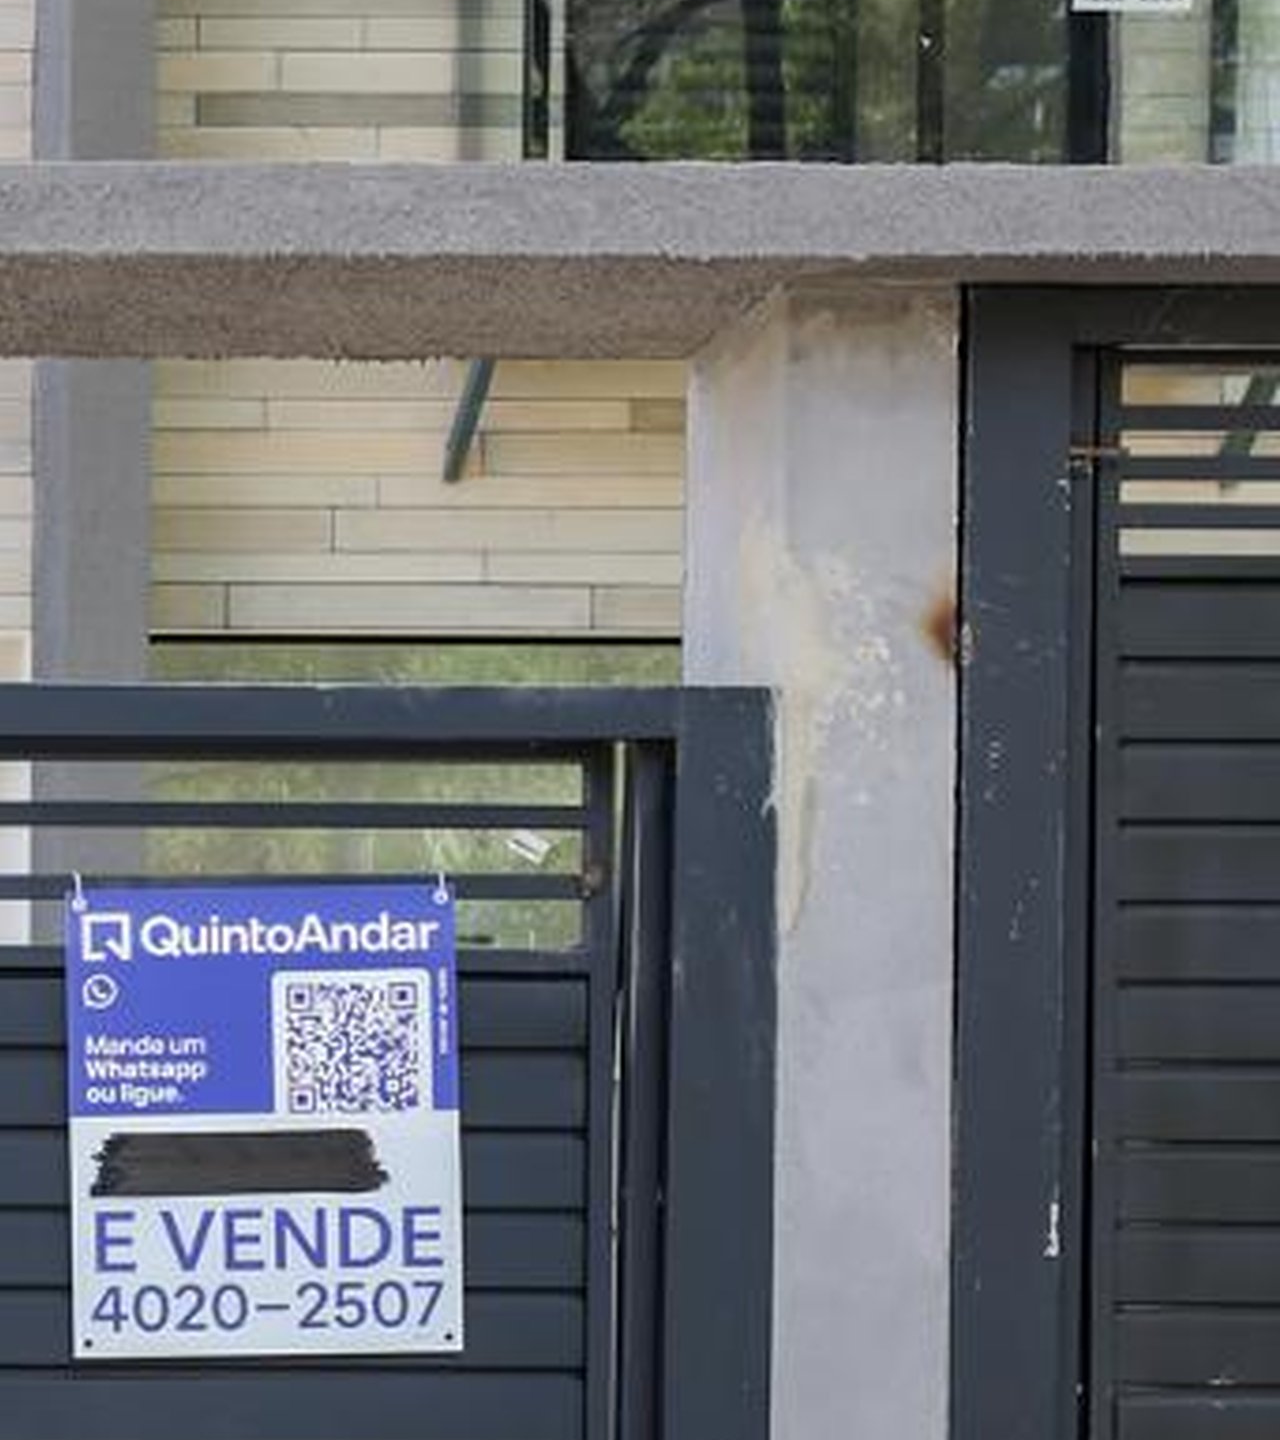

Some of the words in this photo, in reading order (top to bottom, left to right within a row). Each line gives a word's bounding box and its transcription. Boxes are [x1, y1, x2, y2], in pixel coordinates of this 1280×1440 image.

[141, 912, 439, 956] QuintoAndar
[85, 1034, 165, 1055] Mande
[169, 1037, 206, 1054] um
[86, 1086, 116, 1104] ou
[94, 1210, 137, 1272] E
[160, 1206, 443, 1271] VENDE
[91, 1281, 443, 1333] 4020-2507
